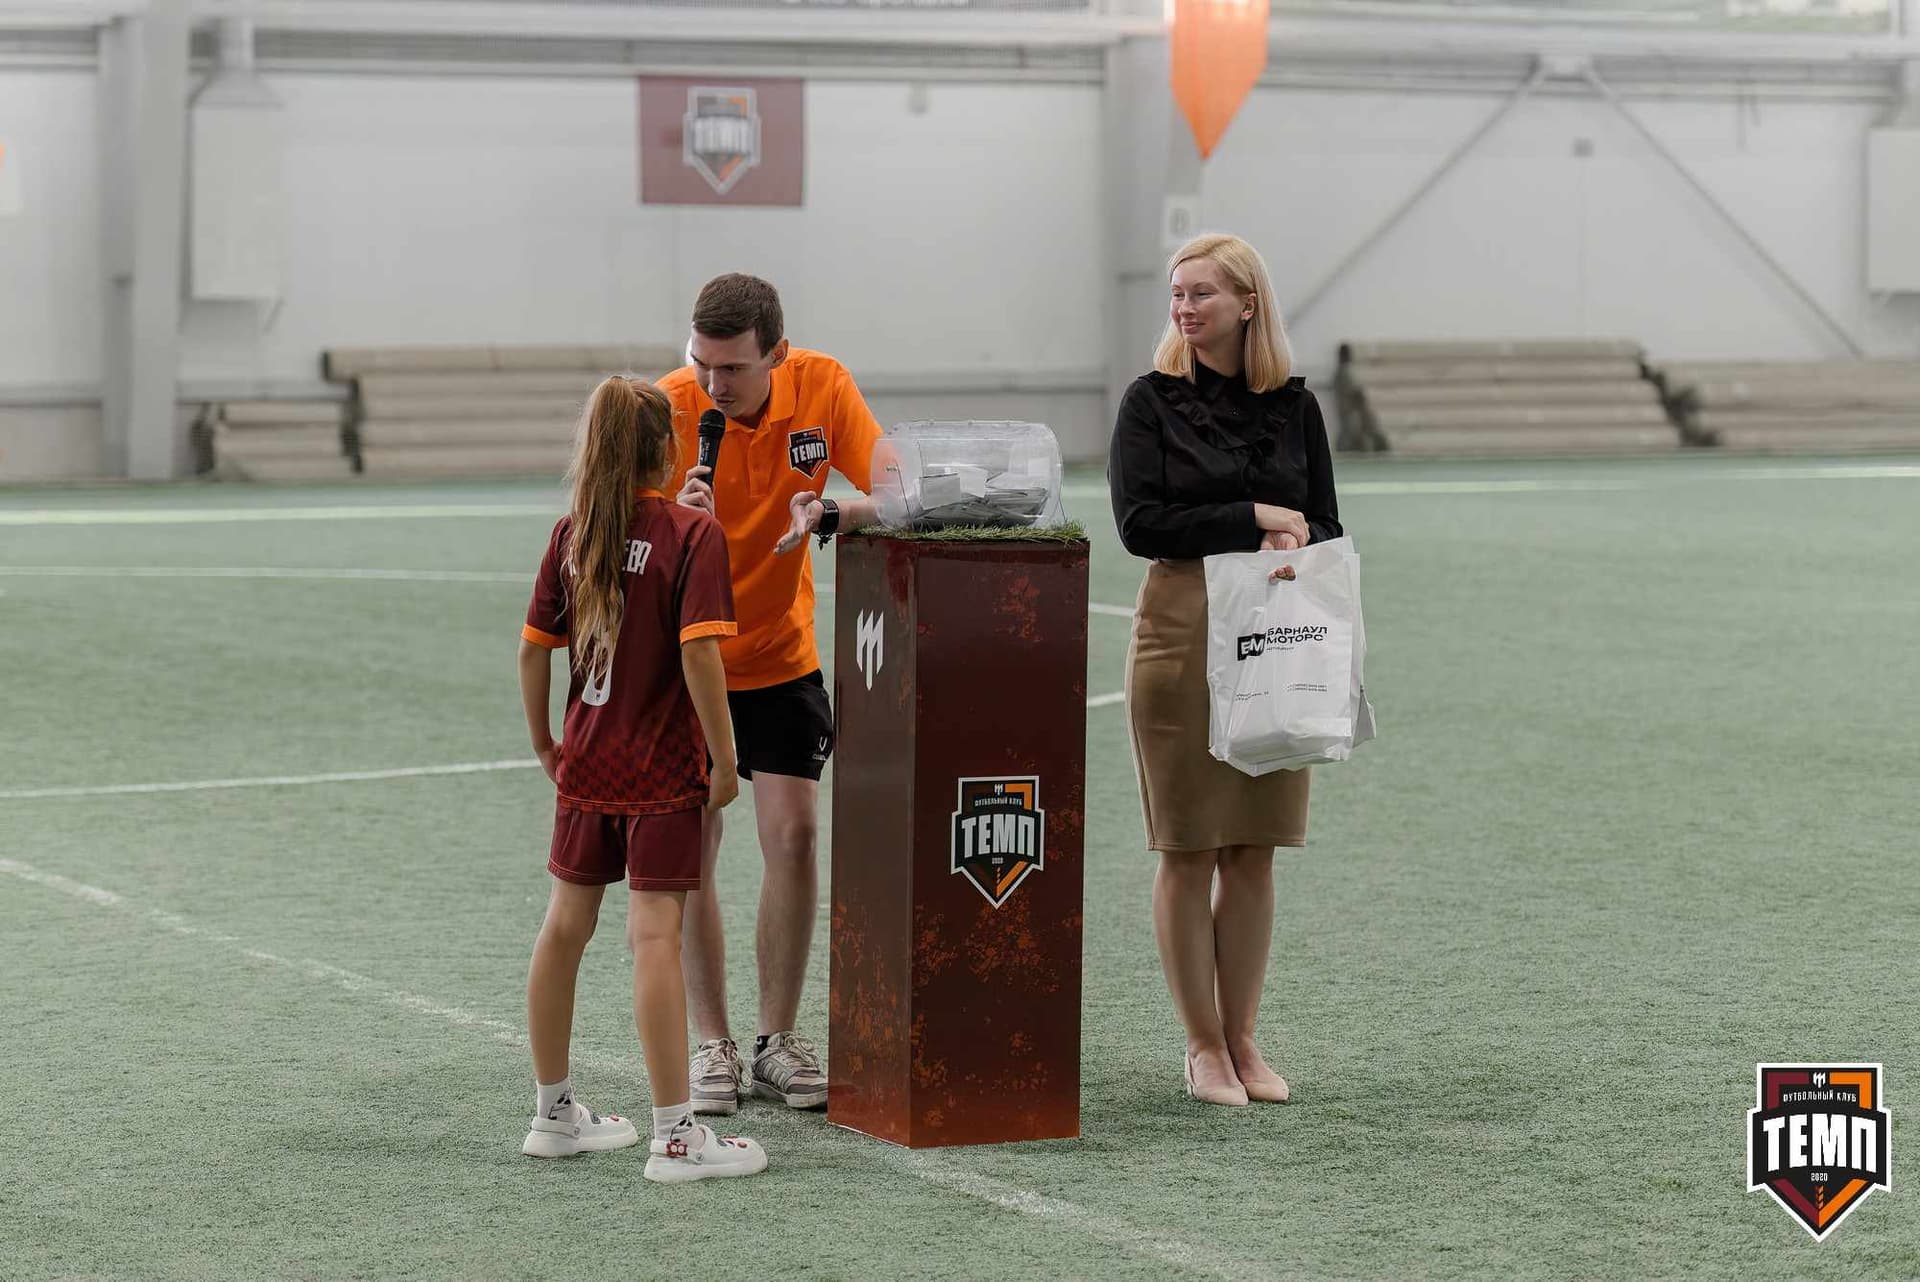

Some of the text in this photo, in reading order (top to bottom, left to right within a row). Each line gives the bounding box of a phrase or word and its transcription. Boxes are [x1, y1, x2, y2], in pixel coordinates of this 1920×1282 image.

[792, 443, 825, 464] ТЕМП
[1267, 626, 1328, 636] БАРНАУЛ
[1266, 634, 1324, 645] МОТОРС
[961, 813, 1035, 859] ТЕМП
